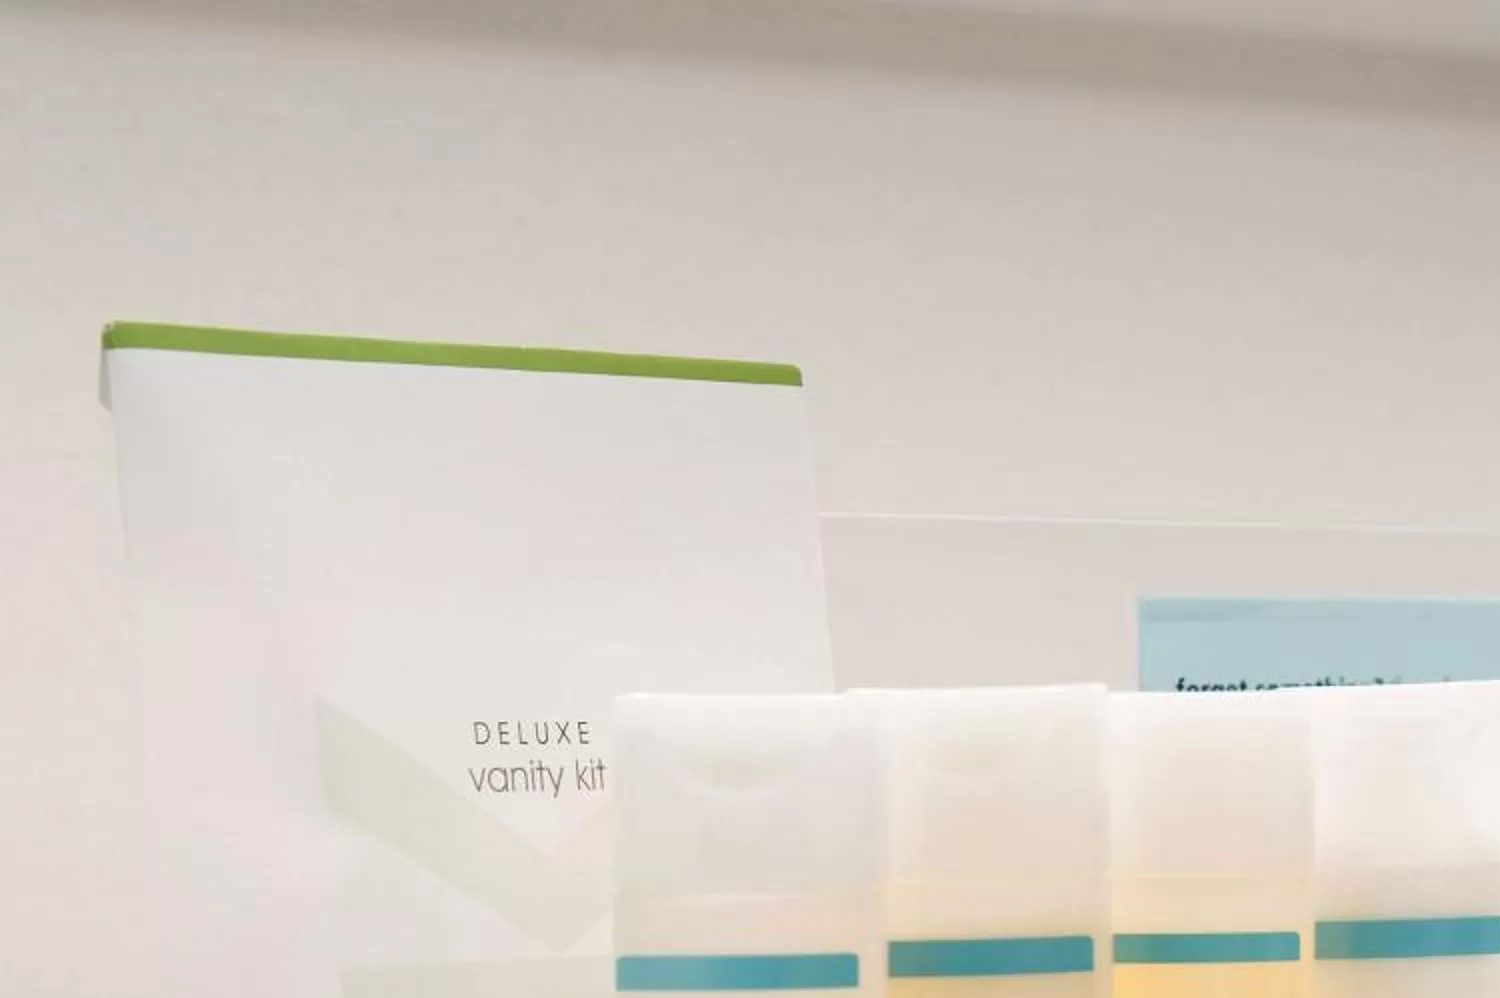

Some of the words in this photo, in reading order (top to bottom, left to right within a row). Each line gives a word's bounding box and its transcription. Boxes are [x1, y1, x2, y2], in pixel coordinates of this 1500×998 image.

[473, 721, 590, 745] DELUXE
[468, 759, 564, 798] vanity
[575, 757, 607, 791] kit
